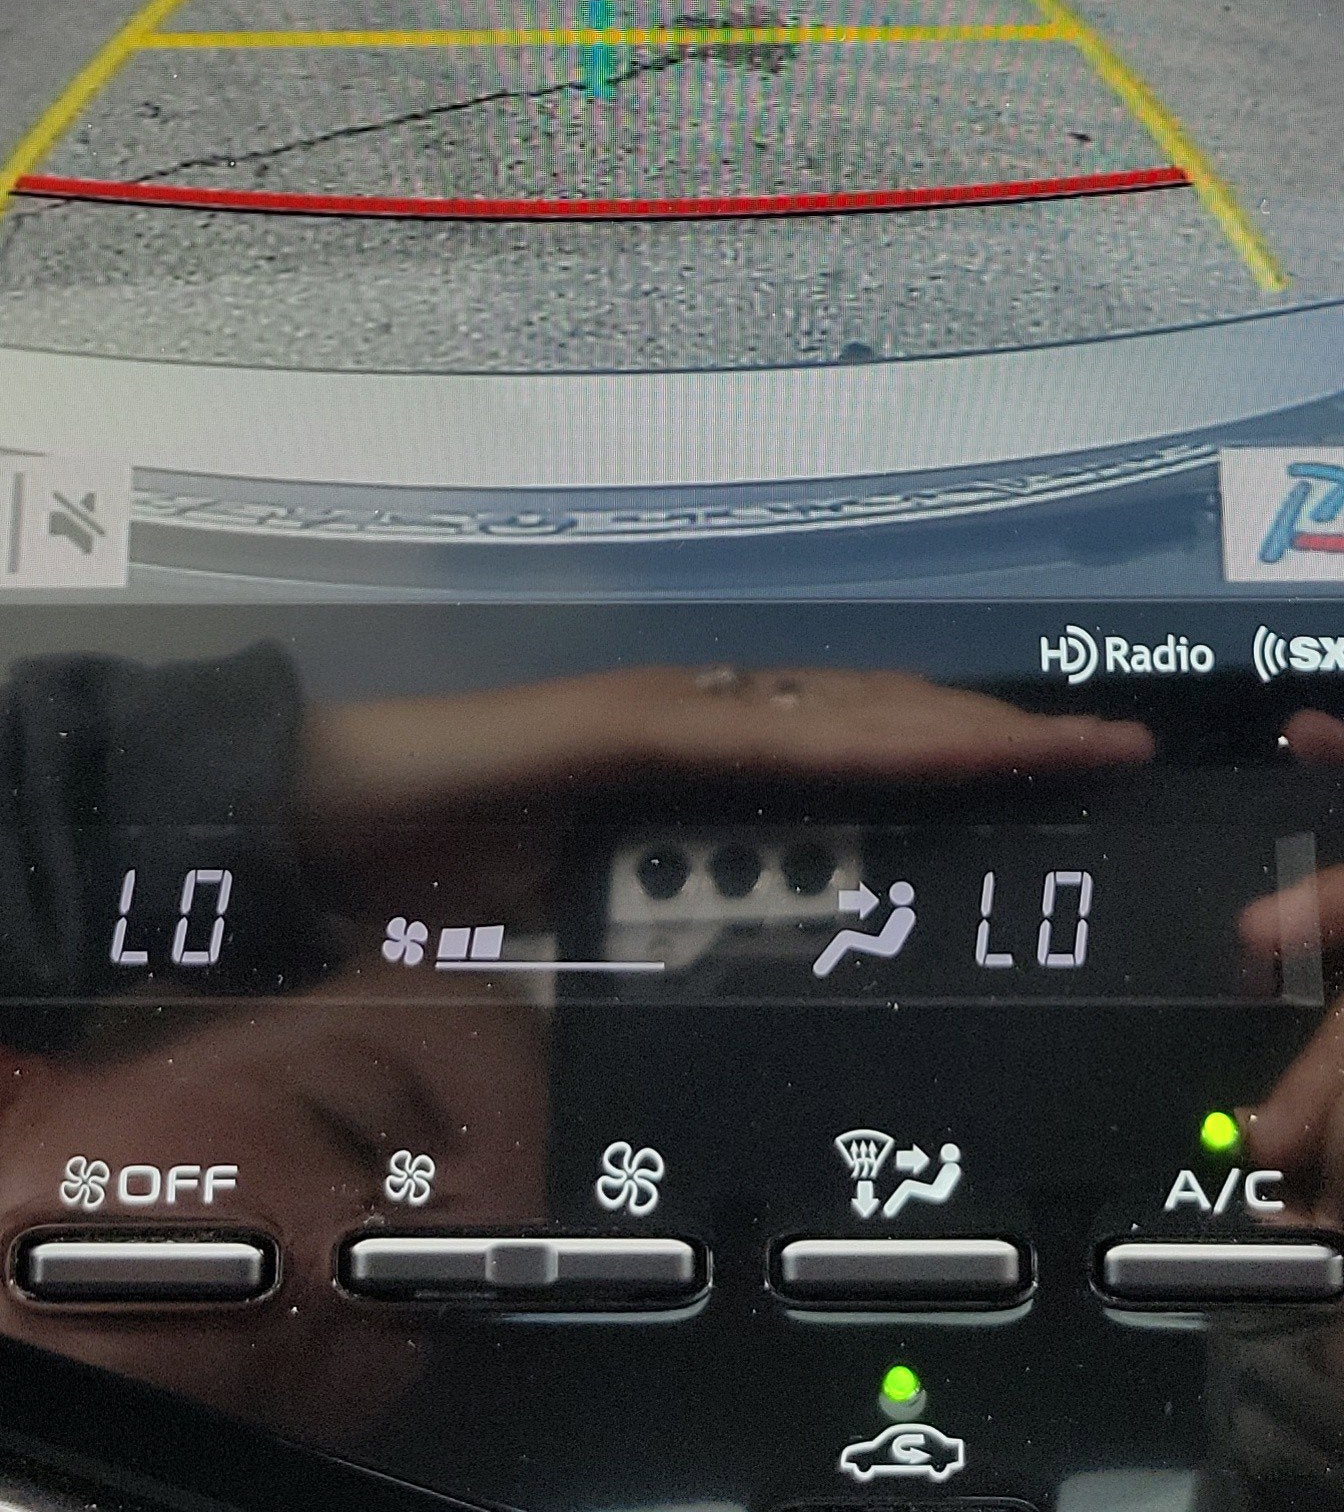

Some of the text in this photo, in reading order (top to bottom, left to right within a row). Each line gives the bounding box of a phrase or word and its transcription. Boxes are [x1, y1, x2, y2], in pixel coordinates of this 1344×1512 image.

[1105, 633, 1214, 674] Radio
[117, 1164, 239, 1204] OFF
[1164, 1168, 1285, 1214] A/C
